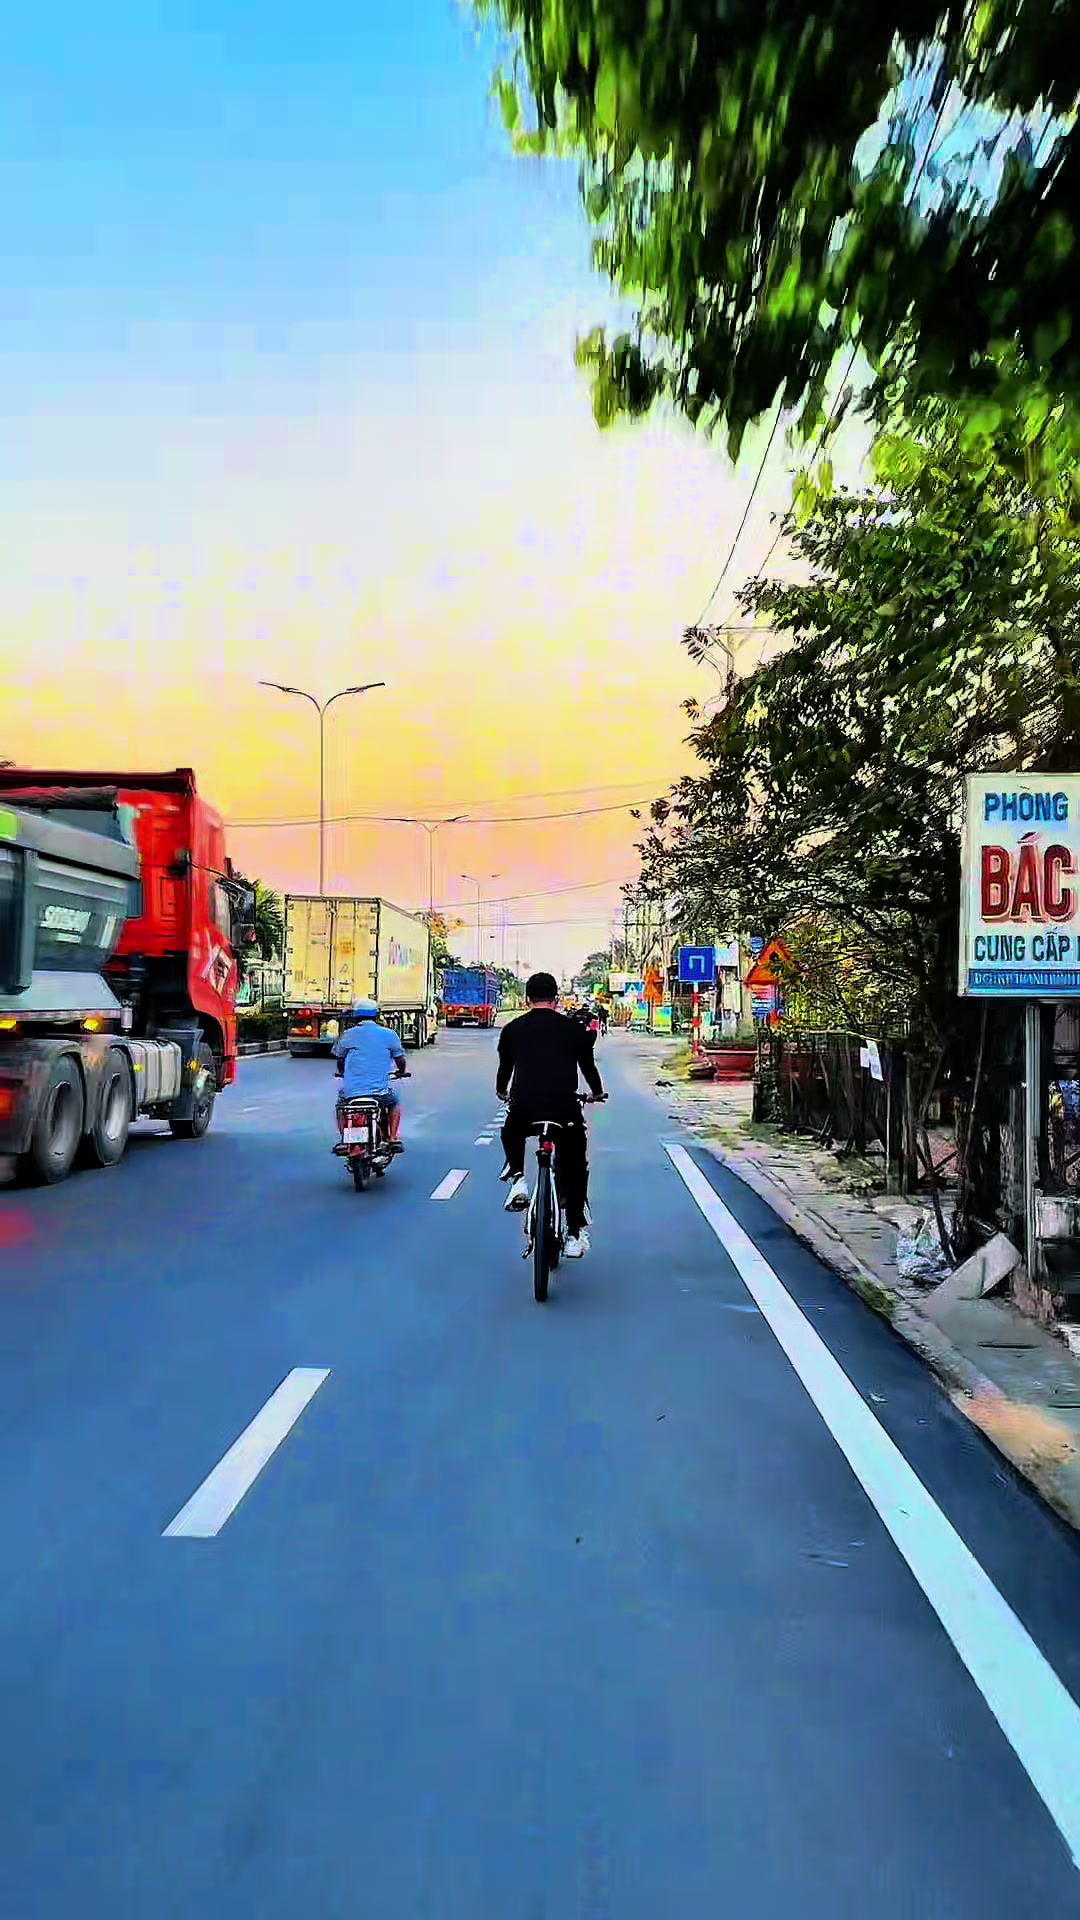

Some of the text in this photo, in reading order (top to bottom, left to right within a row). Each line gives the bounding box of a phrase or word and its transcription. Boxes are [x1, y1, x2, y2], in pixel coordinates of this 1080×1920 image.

[984, 785, 1069, 821] PHÒNG
[981, 832, 1074, 922] BÁC
[974, 935, 1026, 961] CUNG
[1032, 927, 1070, 961] CẤP
